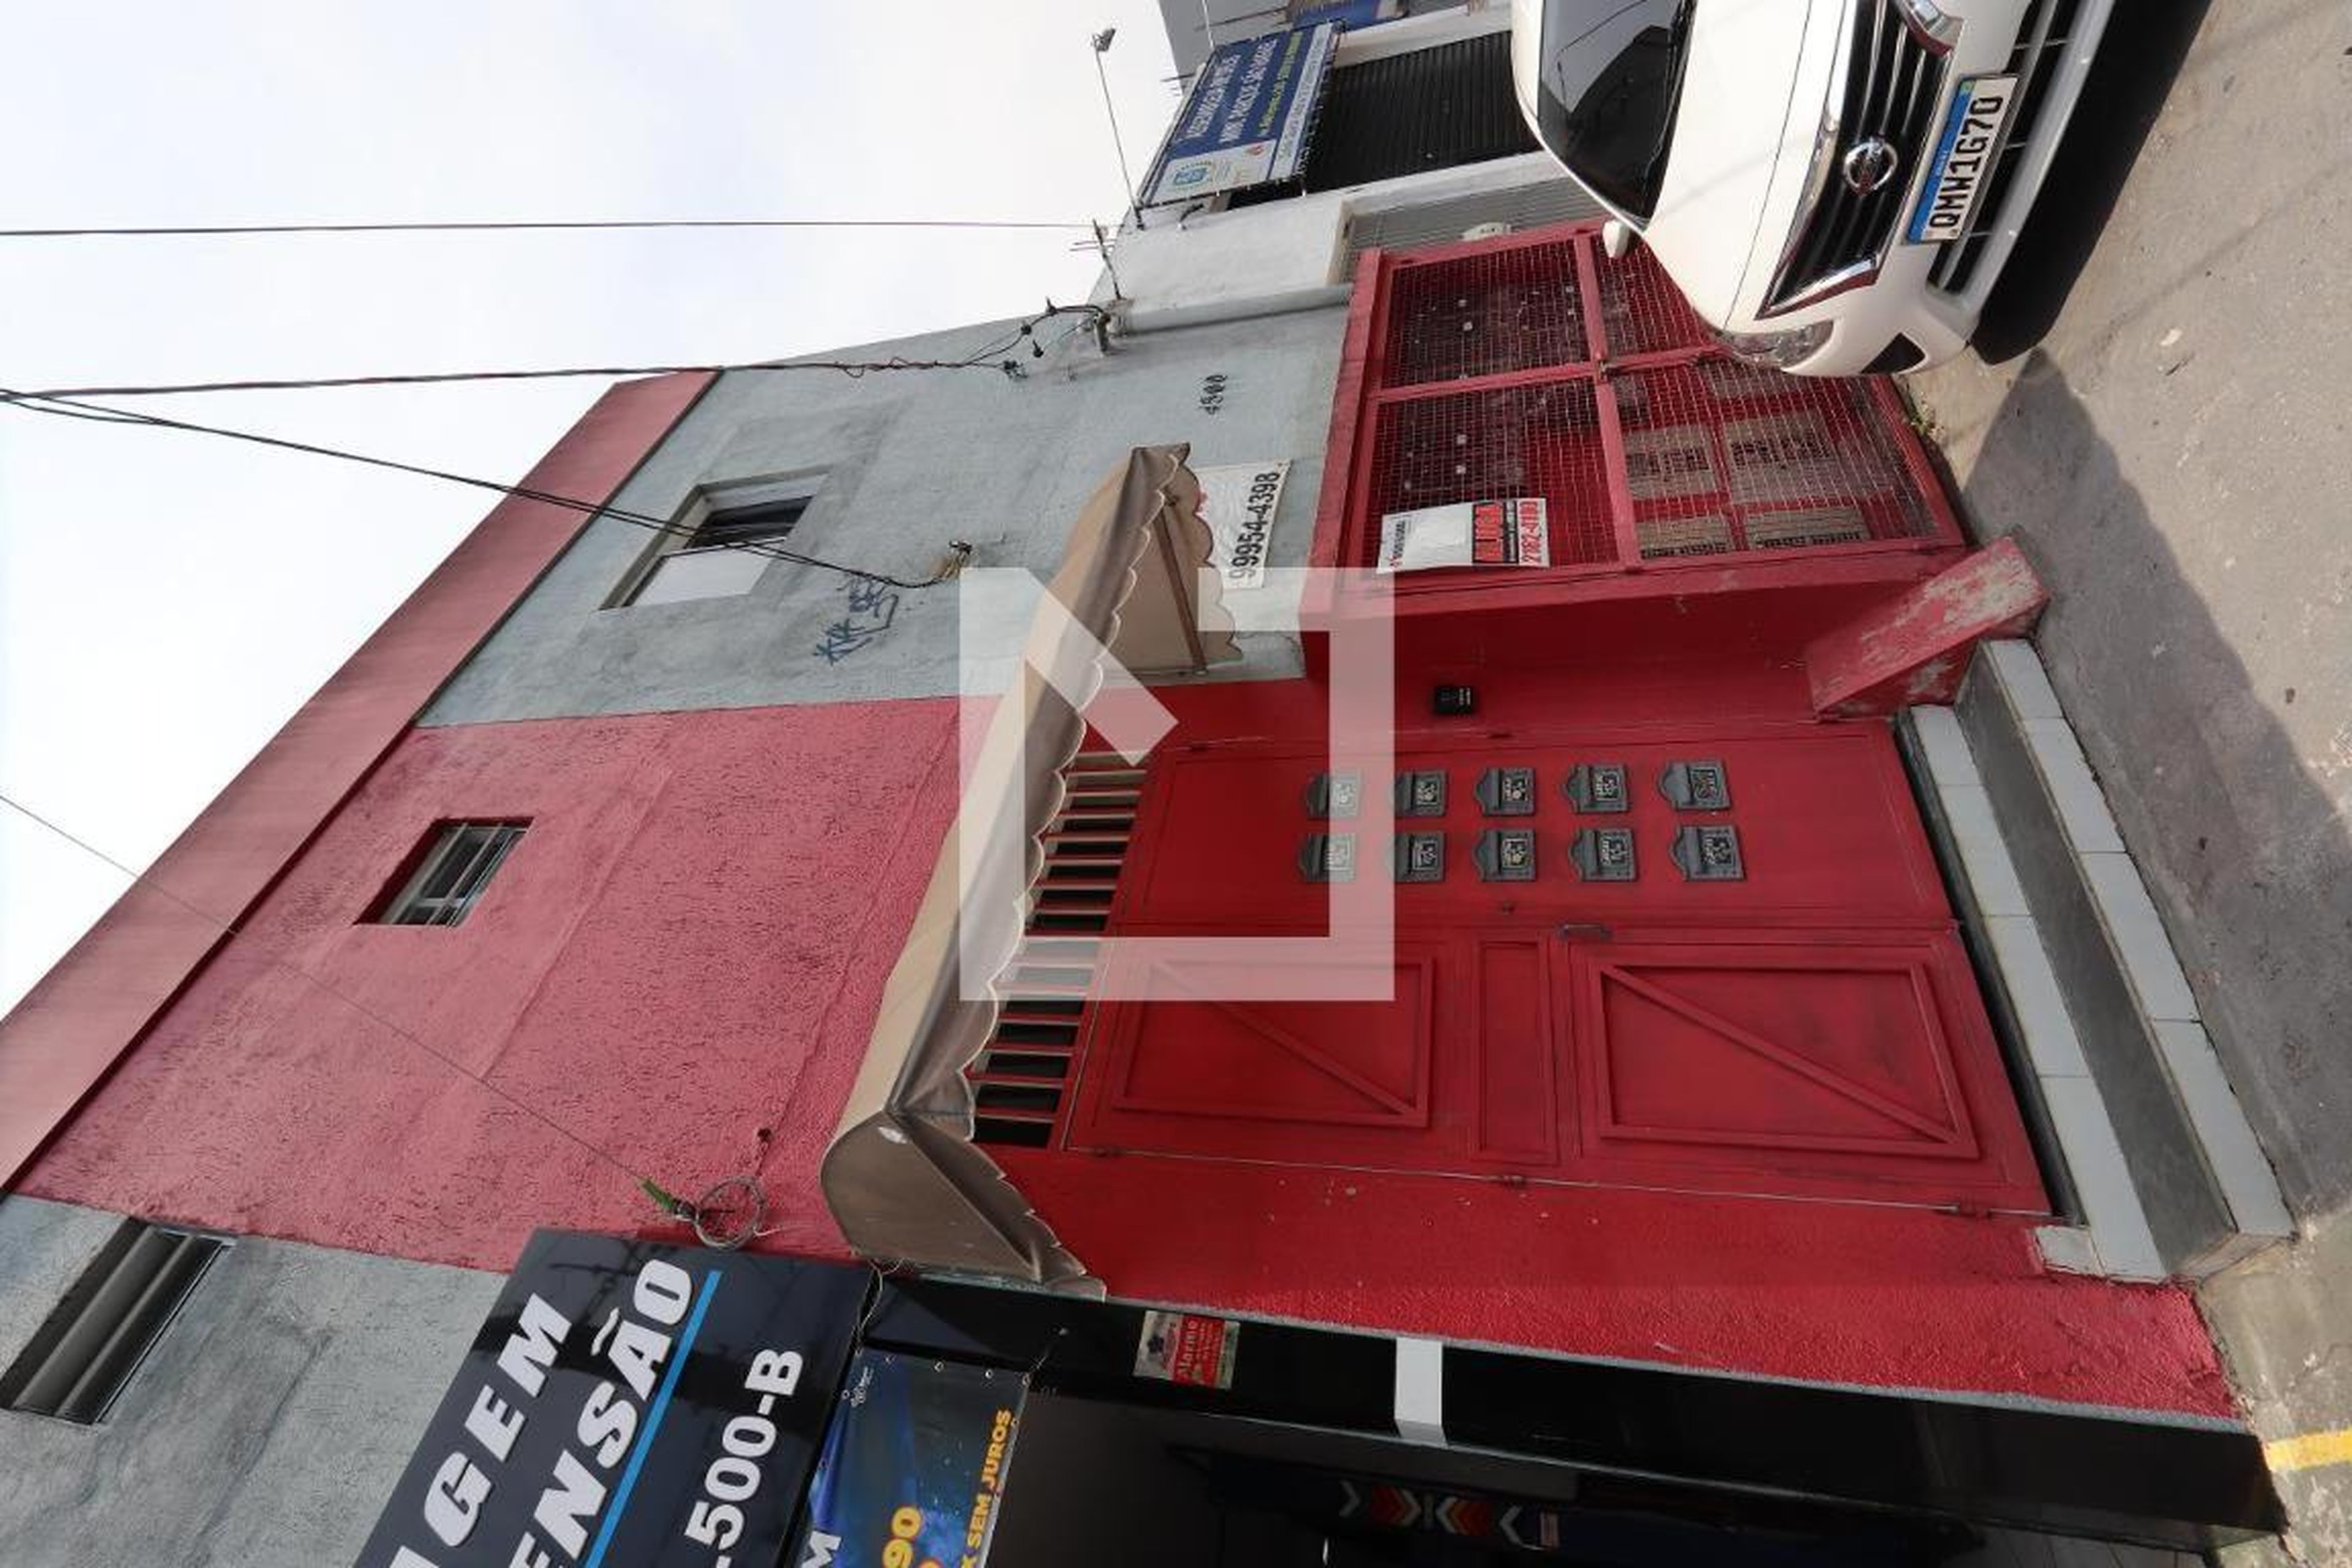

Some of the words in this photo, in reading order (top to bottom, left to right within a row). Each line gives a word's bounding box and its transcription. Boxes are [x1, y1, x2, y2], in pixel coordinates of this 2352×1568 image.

[1929, 96, 2004, 228] QMW1G70
[390, 1293, 572, 1568] GEM
[967, 1493, 992, 1548] SEM
[982, 1409, 1012, 1490] JUROS
